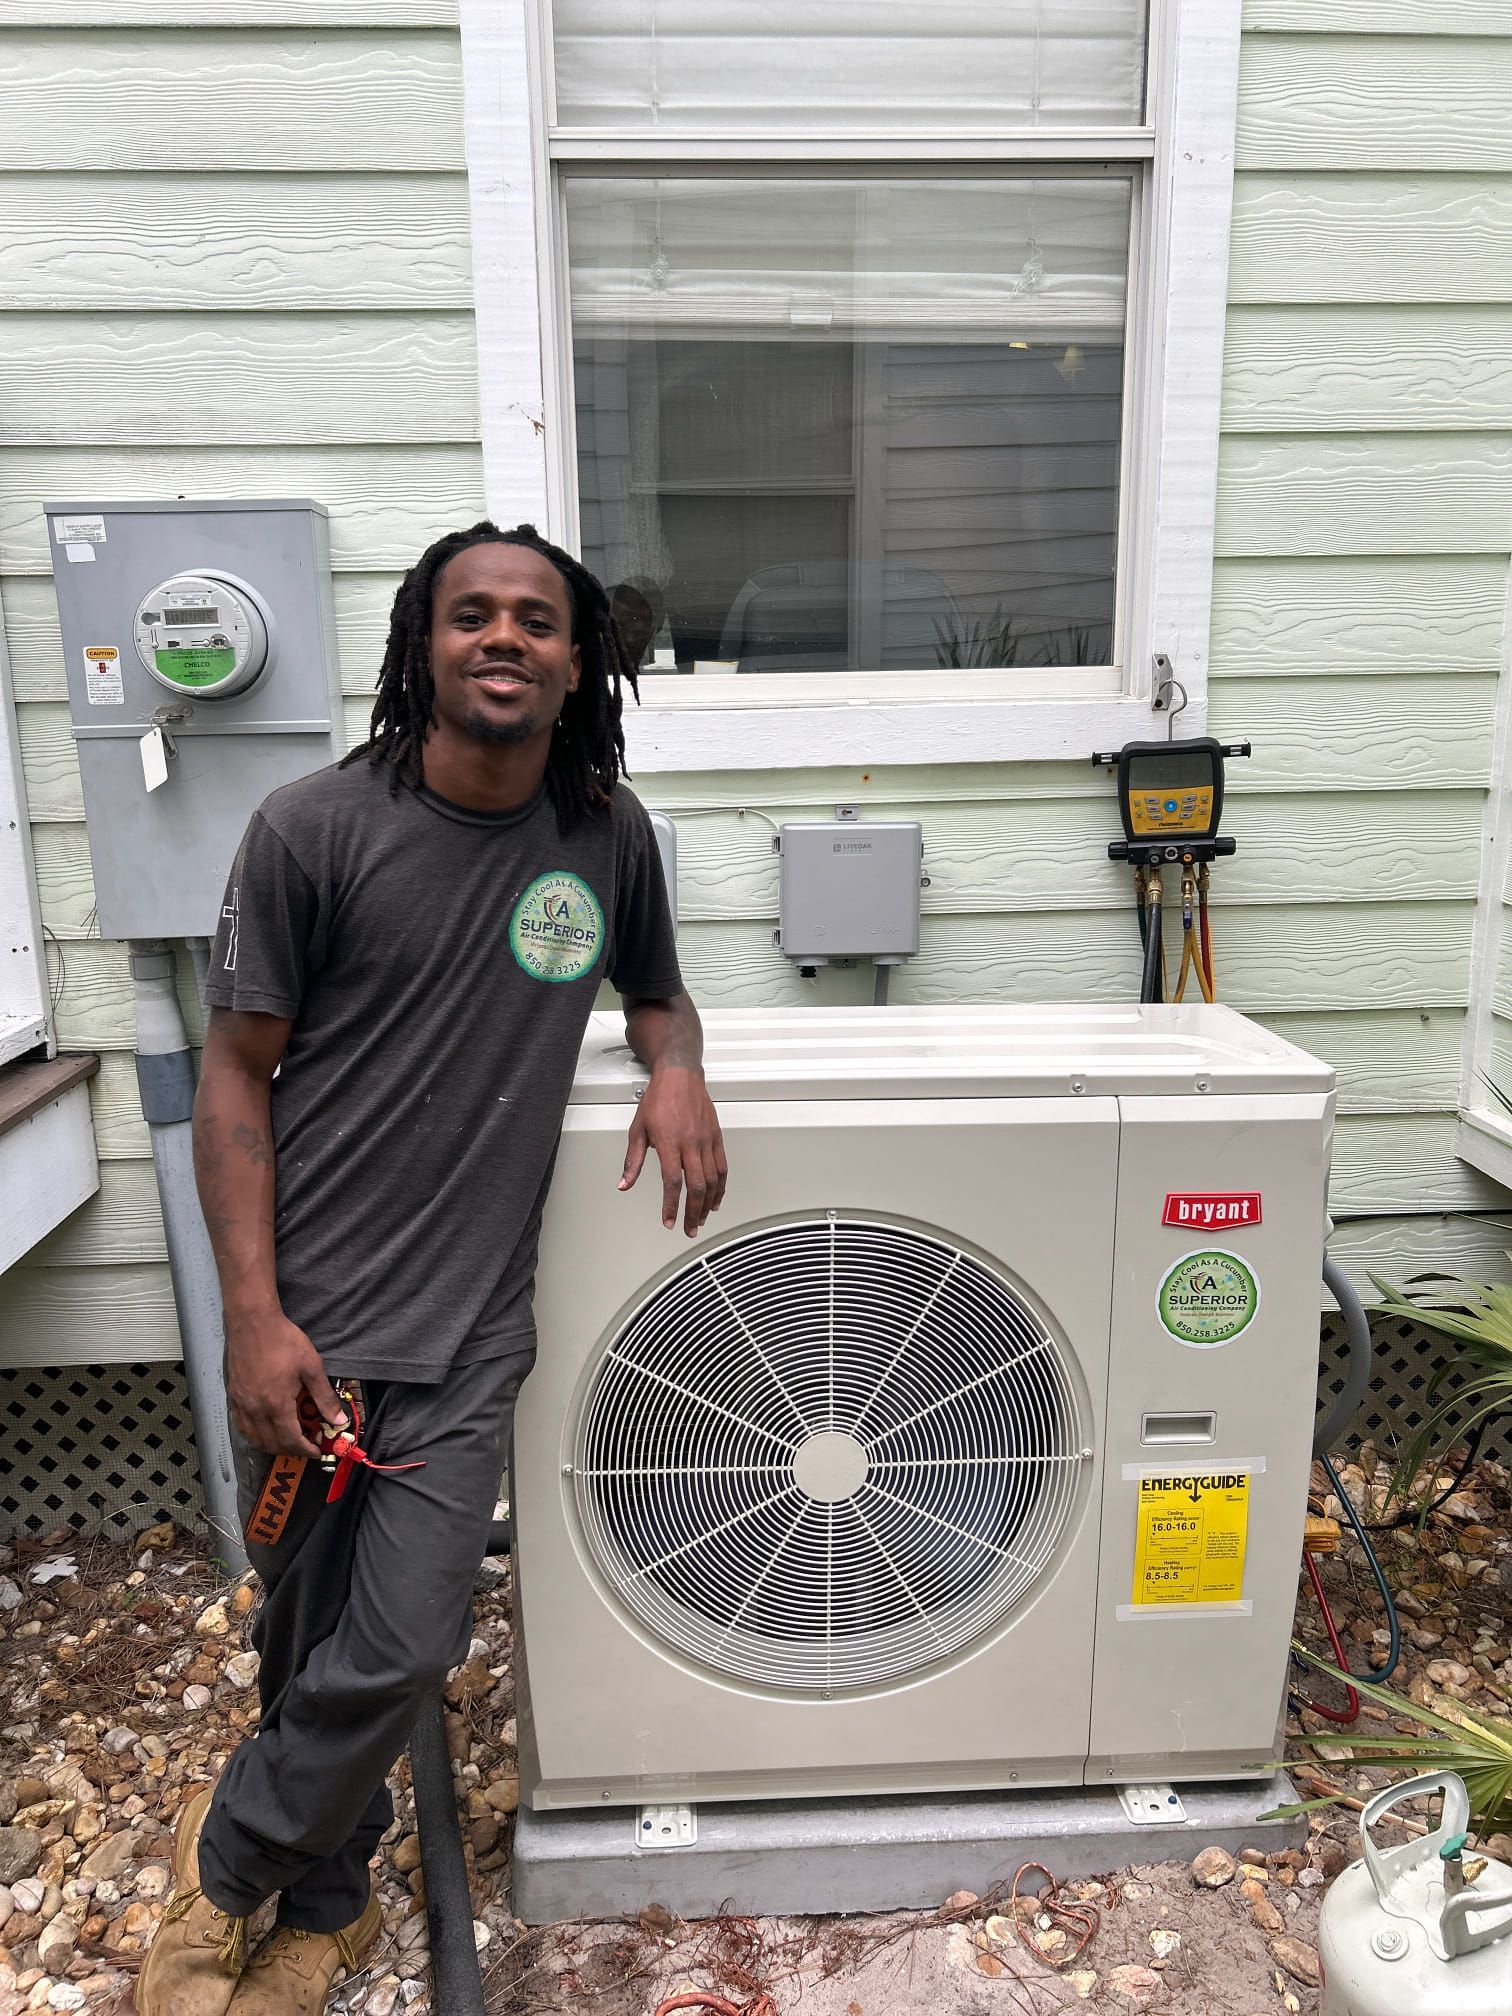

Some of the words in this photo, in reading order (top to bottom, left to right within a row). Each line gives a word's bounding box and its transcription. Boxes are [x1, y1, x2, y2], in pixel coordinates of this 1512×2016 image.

[522, 896, 537, 915] Stay
[535, 880, 554, 896] Cool
[567, 881, 573, 889] A
[574, 885, 596, 928] Cucumber
[520, 918, 596, 943] SUPERIOR
[531, 933, 565, 945] Conditioning
[566, 939, 593, 951] Company
[1178, 1200, 1250, 1223] bryant
[1170, 1276, 1184, 1293] Stay
[1181, 1262, 1200, 1276] Cool
[1220, 1260, 1247, 1293] Cucumber
[1168, 1295, 1248, 1305] SUPERIOR
[1176, 1320, 1235, 1338] 850.258.3225
[1141, 1475, 1246, 1492] ENERGYGUIDE
[1152, 1522, 1196, 1531] 16.0-16.0
[1145, 1571, 1179, 1581] 8.5-8.5
